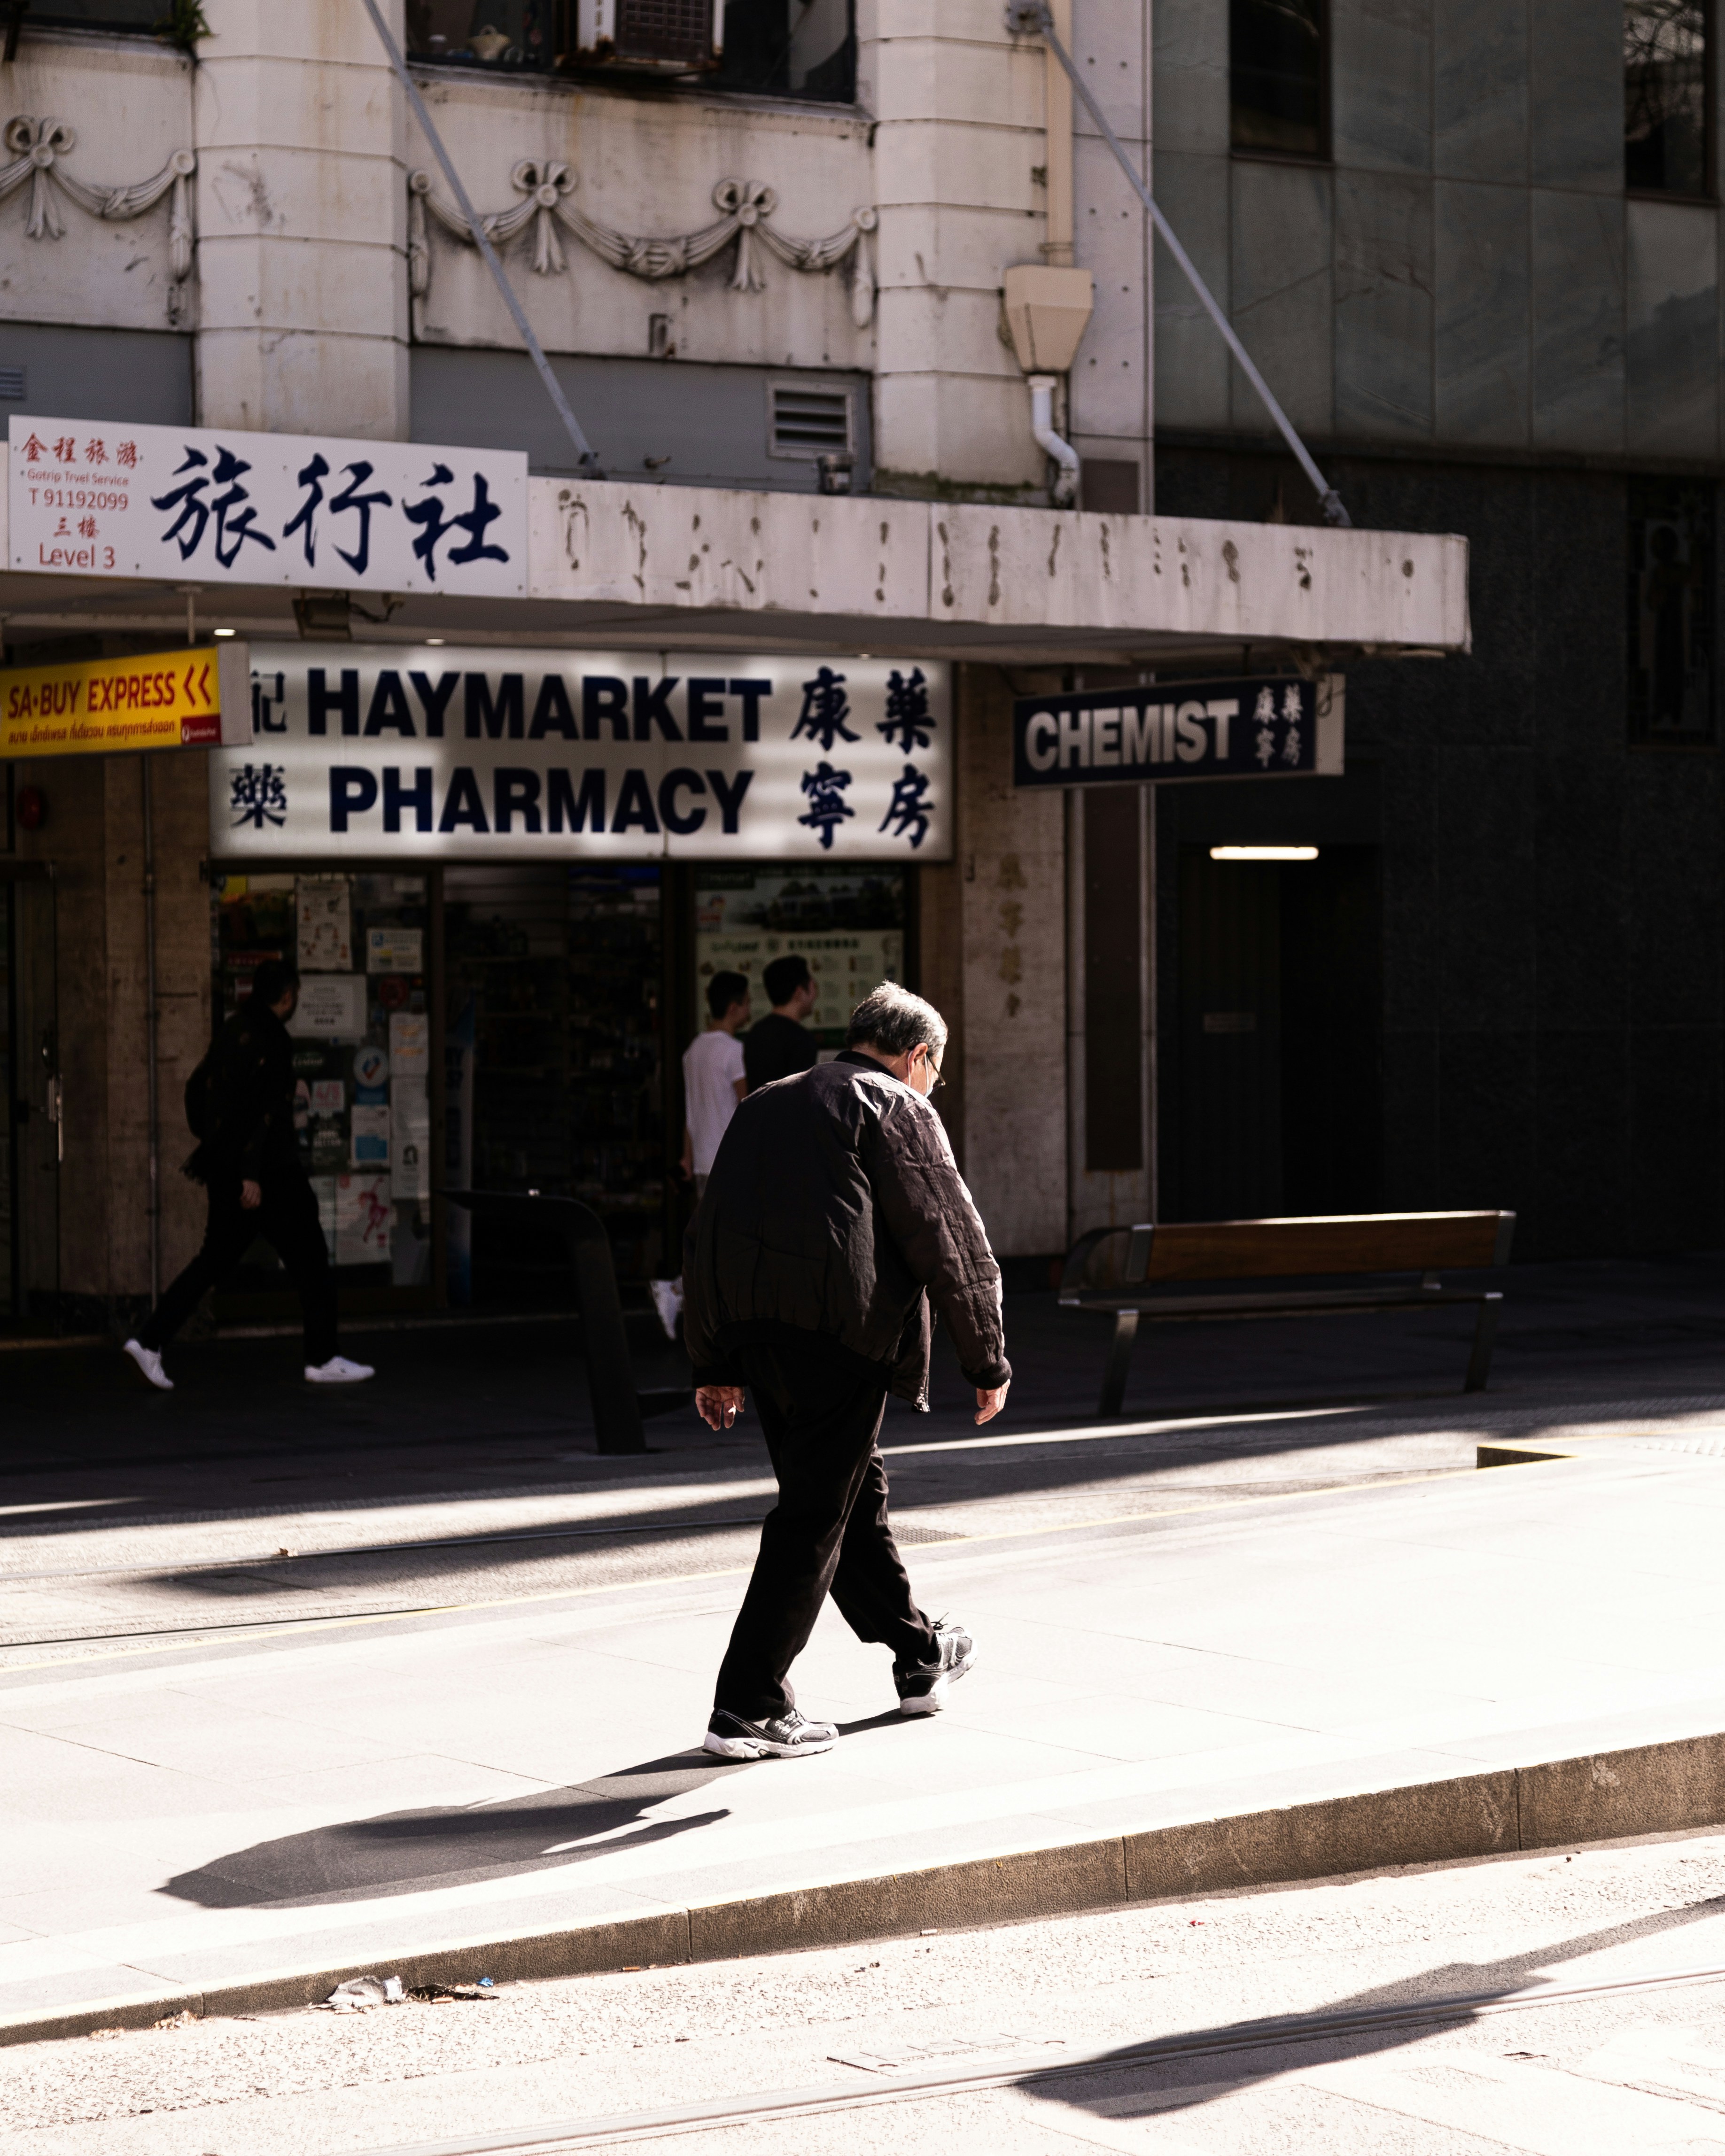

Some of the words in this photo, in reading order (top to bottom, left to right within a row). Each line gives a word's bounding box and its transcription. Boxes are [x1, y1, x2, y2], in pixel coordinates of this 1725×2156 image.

[27, 468, 62, 483] Gotrip
[92, 473, 129, 487] Service
[29, 488, 39, 506] T
[44, 488, 129, 511] 91192099
[151, 444, 510, 582] 旅行社
[39, 542, 95, 568] Level
[103, 545, 115, 569] 3
[86, 671, 176, 713] EXPRESS
[307, 667, 772, 742] HAYMARKET
[1025, 698, 1240, 772] CHEMIST
[329, 766, 754, 835] PHARMACY
